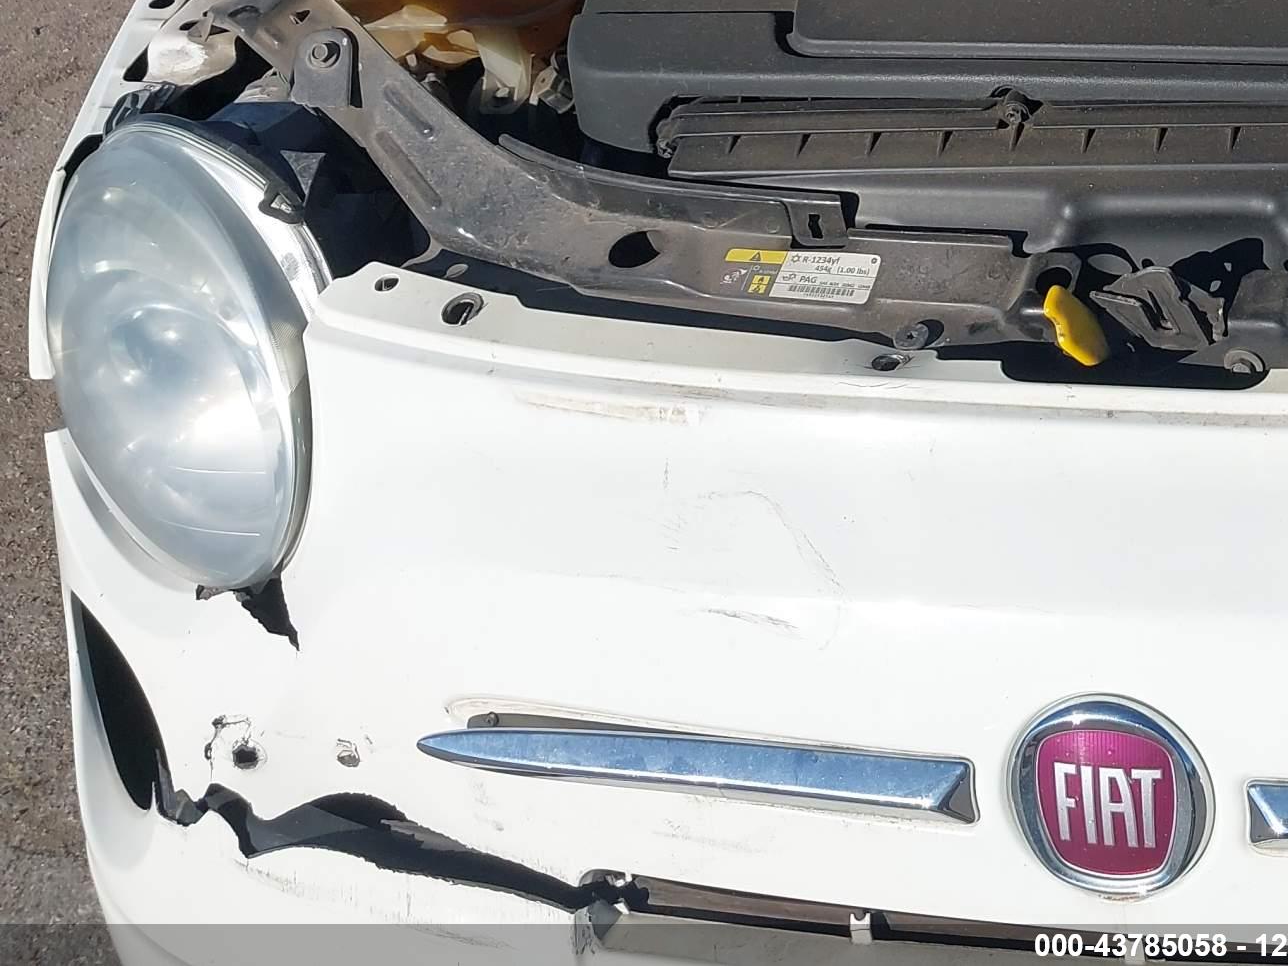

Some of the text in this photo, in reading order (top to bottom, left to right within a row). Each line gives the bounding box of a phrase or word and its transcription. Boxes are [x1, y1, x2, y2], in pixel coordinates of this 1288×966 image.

[802, 256, 841, 266] R-1234yf
[815, 265, 870, 275] 454g (1.00 lbs)
[799, 275, 818, 284] PAG
[1053, 761, 1163, 849] FIAT
